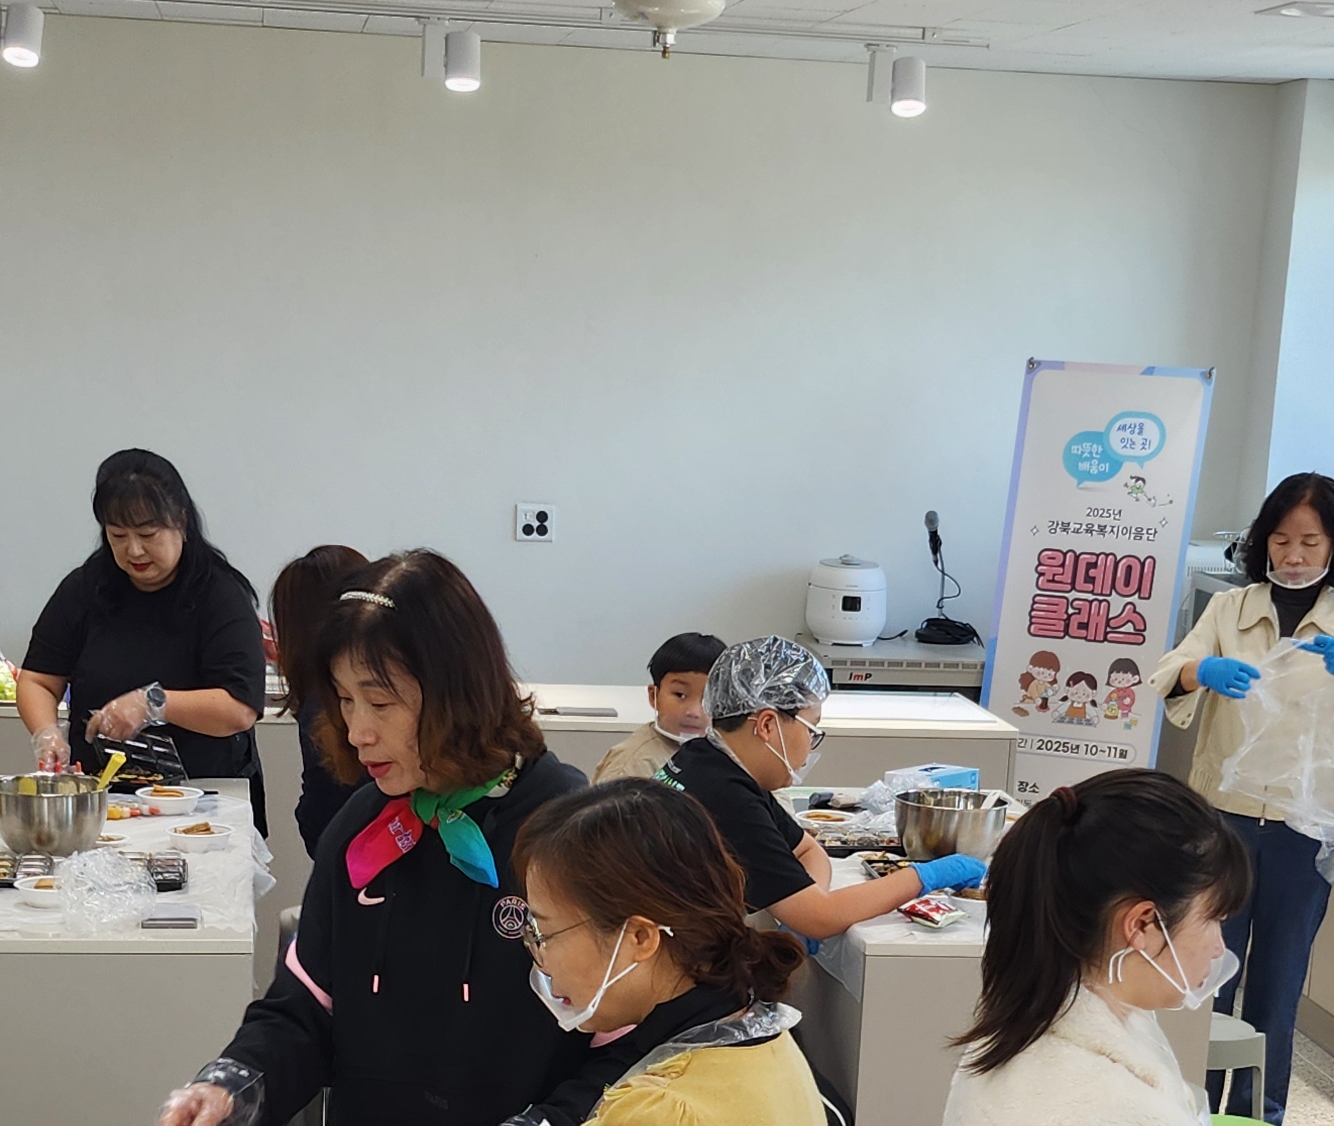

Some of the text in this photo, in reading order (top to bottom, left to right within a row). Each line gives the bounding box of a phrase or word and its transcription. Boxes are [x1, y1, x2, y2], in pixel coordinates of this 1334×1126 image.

[1117, 422, 1145, 436] 세상을
[1071, 442, 1103, 459] 따뜻한
[1078, 459, 1110, 474] 배움이
[1085, 507, 1123, 521] 2025년
[1047, 520, 1158, 542] 강북교육복지이음단
[1034, 547, 1156, 600] 원데이
[1027, 593, 1147, 645] 클래스
[1036, 739, 1080, 755] 2025년
[1084, 743, 1128, 760] 10~11월
[1017, 781, 1040, 794] 장소
[500, 898, 526, 910] PARIS
